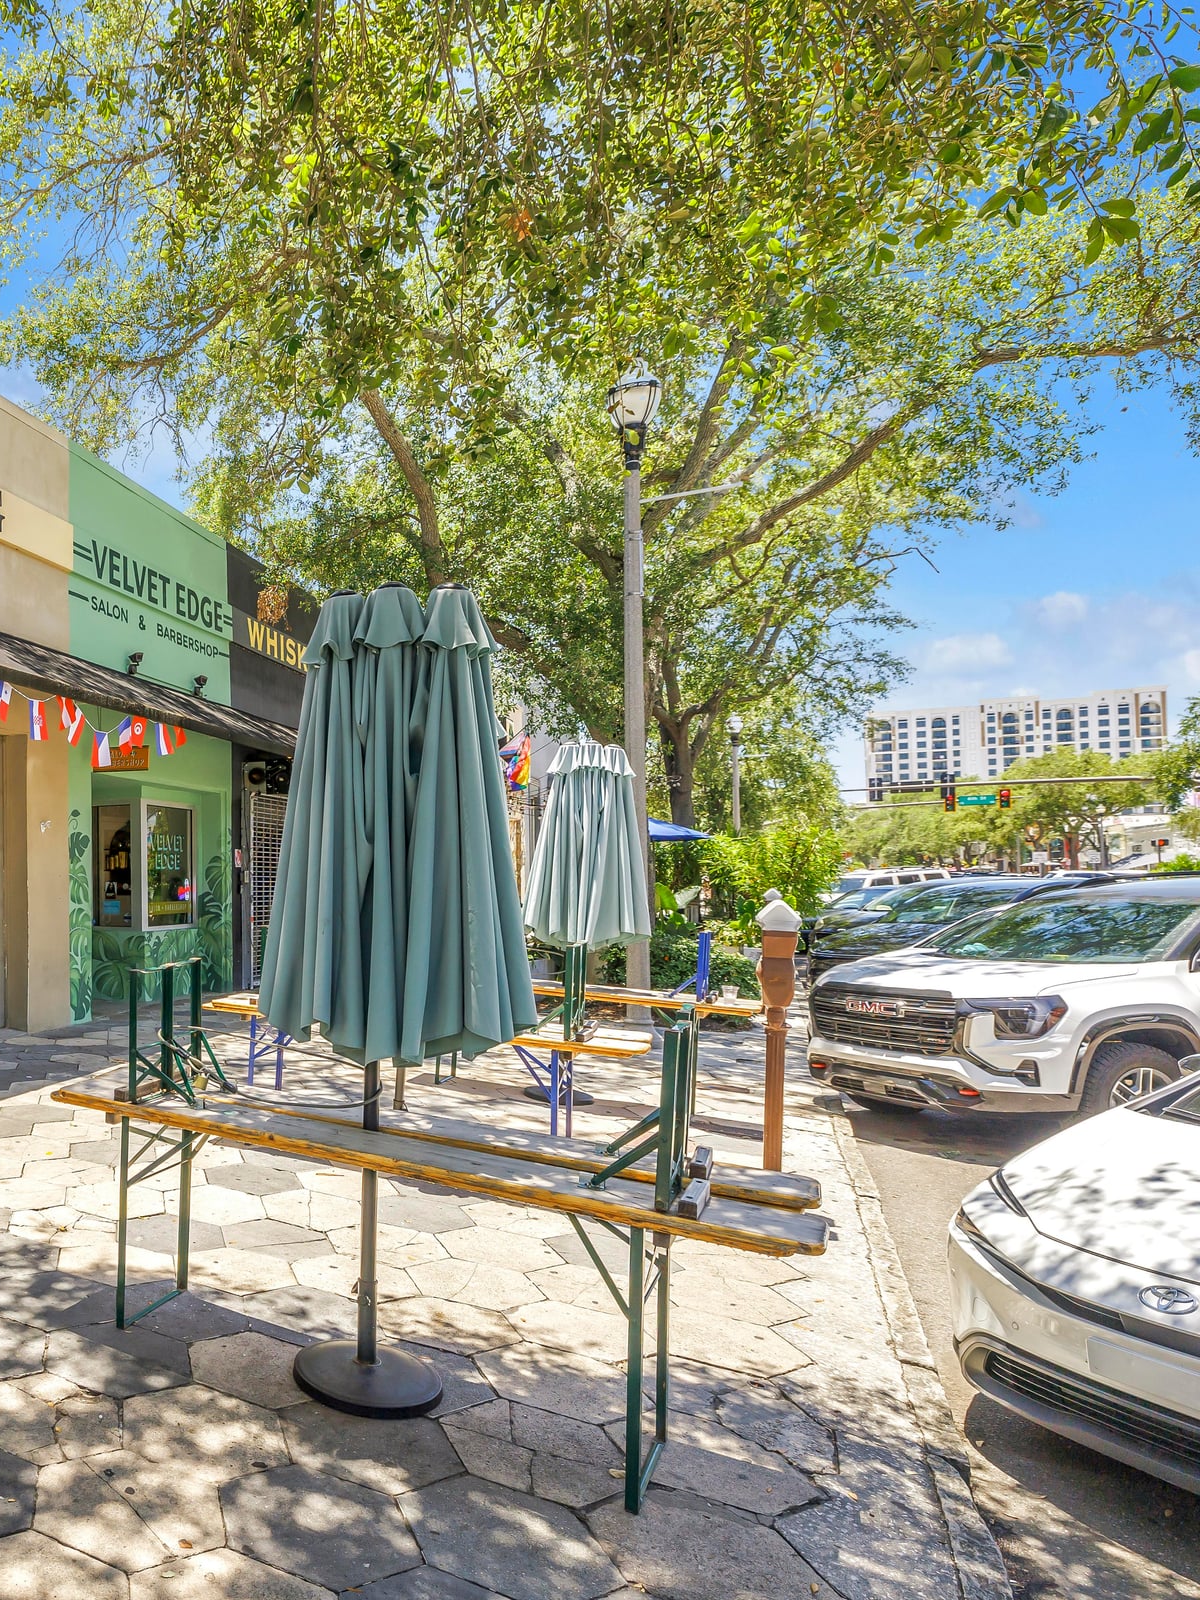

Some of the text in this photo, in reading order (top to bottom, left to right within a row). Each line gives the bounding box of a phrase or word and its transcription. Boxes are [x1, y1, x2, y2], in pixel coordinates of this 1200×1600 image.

[91, 539, 223, 633] VELVET EDGE
[90, 596, 219, 659] SALON & BARBERSHOP
[155, 853, 180, 870] EDGE
[846, 1000, 898, 1016] GMC
